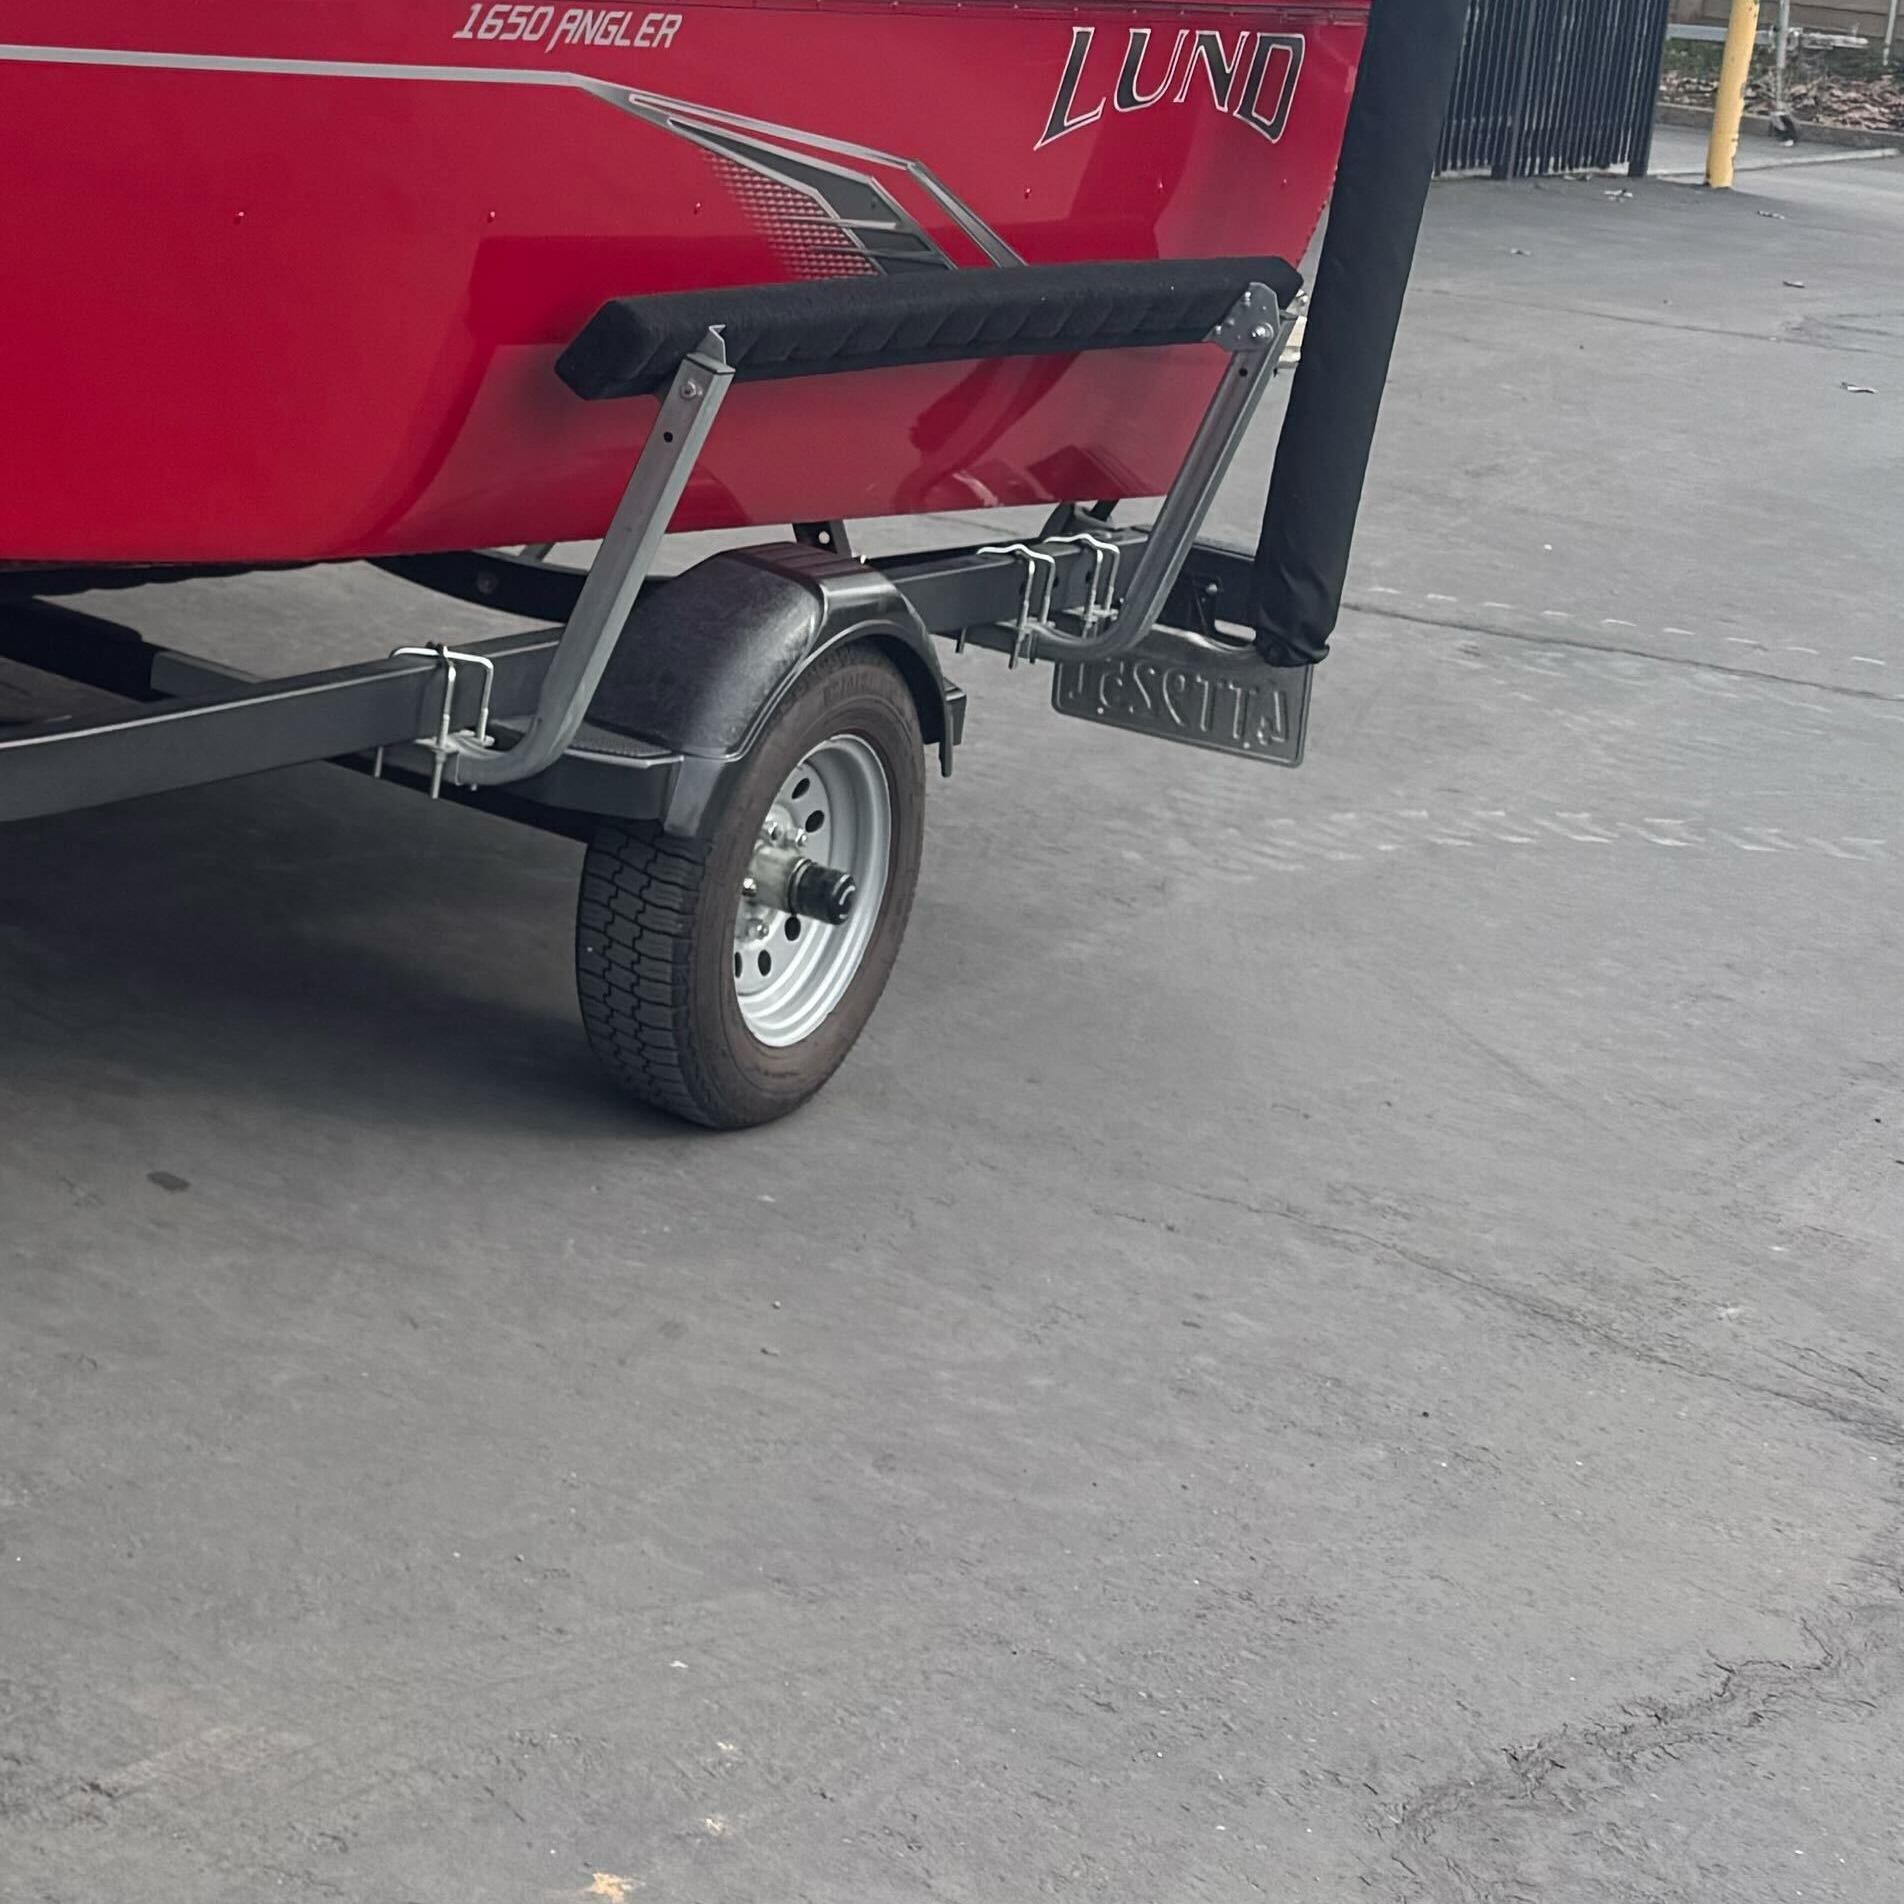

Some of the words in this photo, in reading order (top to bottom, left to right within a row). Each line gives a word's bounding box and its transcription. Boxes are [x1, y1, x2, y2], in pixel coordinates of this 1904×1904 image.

[452, 2, 556, 43] 1650
[544, 7, 683, 54] ANGLER
[1033, 25, 1305, 153] LUND
